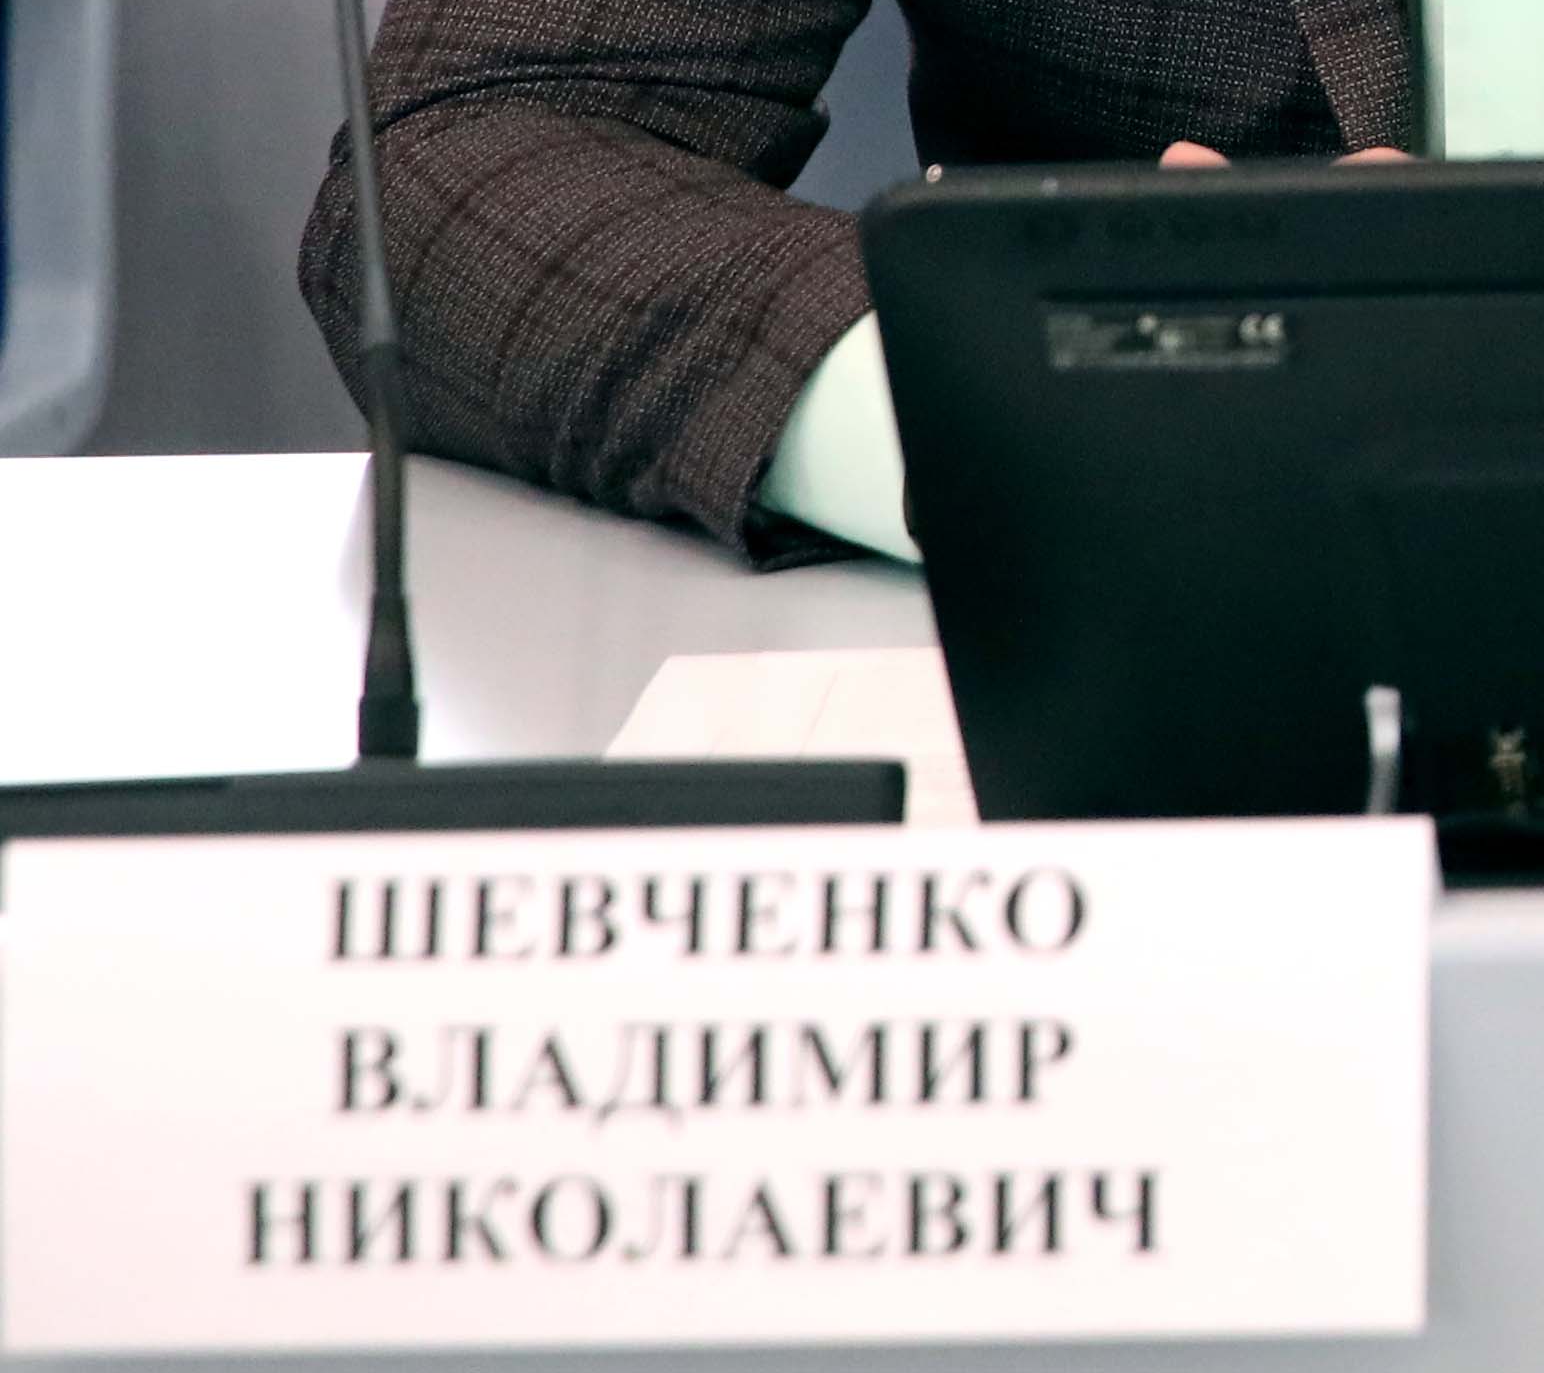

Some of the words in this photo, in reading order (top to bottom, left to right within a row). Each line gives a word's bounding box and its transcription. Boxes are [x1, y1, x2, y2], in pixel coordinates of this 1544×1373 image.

[325, 866, 1093, 966] ШЕВЧЕНКО
[333, 1017, 1079, 1126] ВЛАДИМИР
[241, 1166, 1164, 1268] НИКОЛАЕВИЧ
